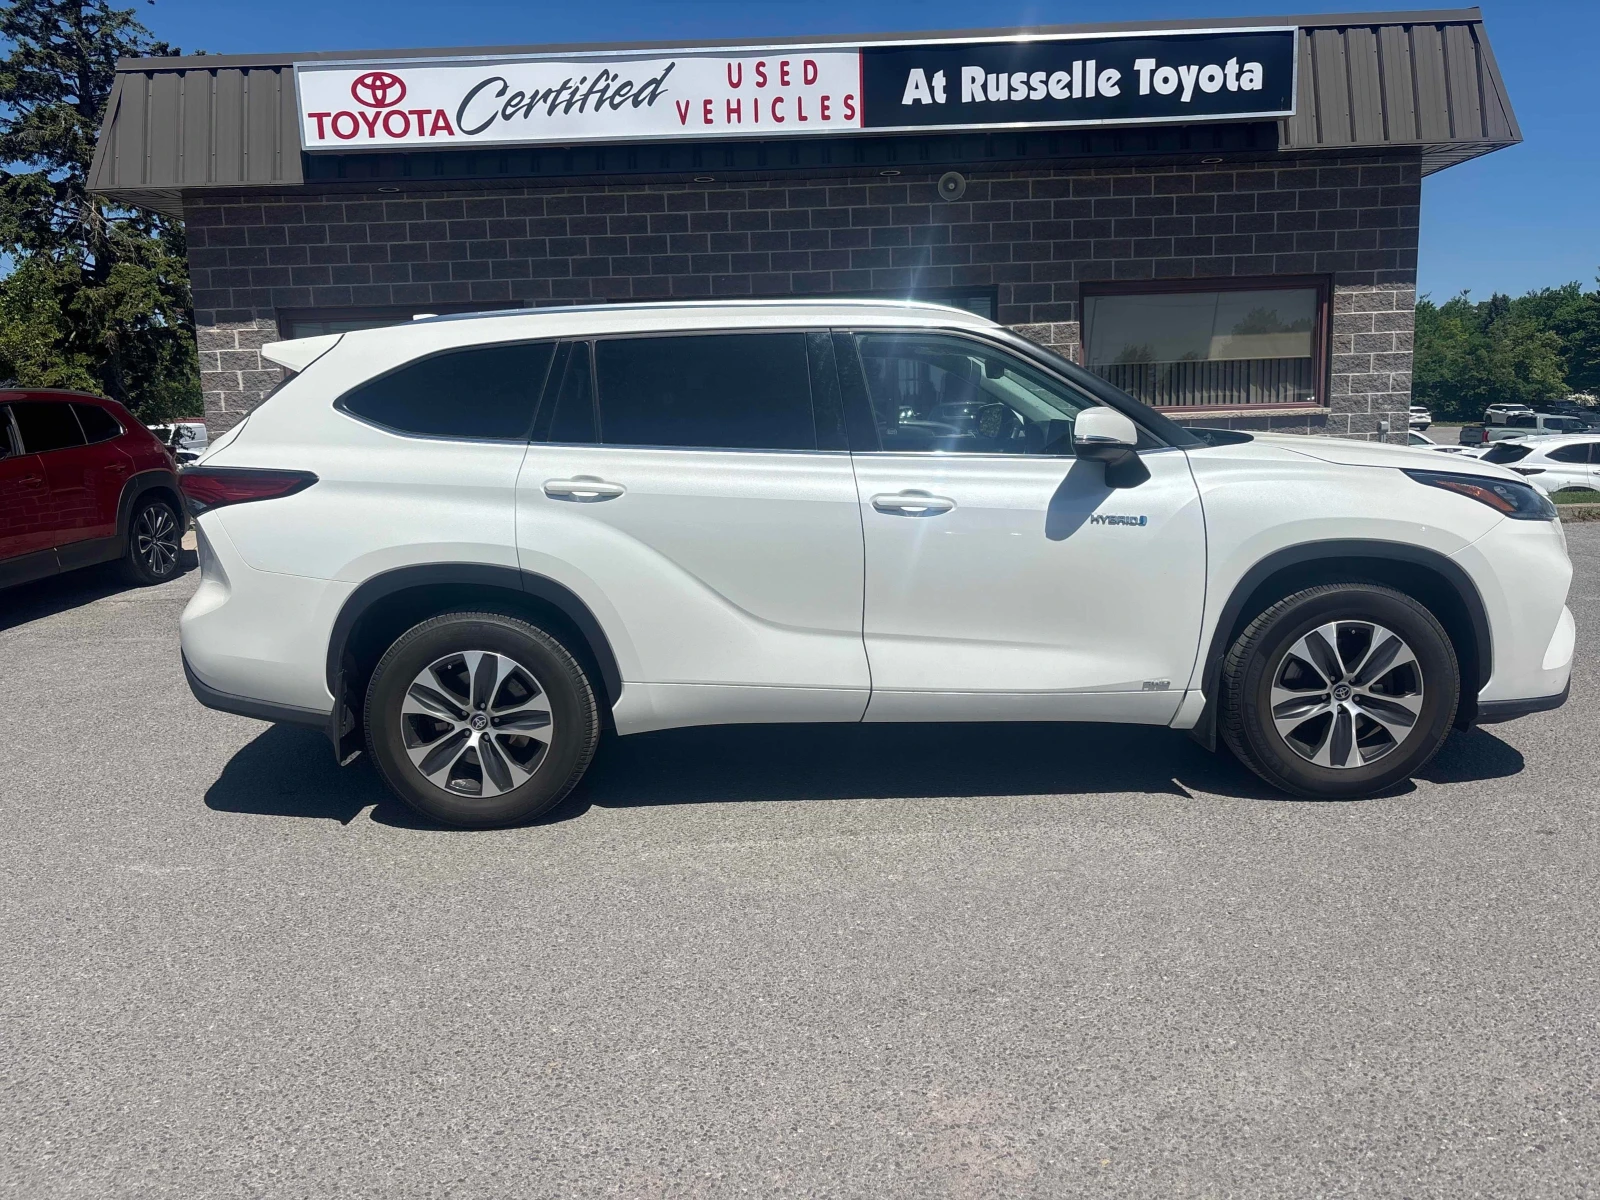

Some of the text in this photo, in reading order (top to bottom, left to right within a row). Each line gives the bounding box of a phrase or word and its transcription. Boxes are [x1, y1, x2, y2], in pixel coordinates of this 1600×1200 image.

[726, 59, 819, 89] USED
[901, 56, 1263, 105] At Russelle Toyota
[307, 61, 676, 140] TOYOTA Certified
[675, 94, 857, 125] VEHICLES
[1090, 514, 1140, 527] HYBRID
